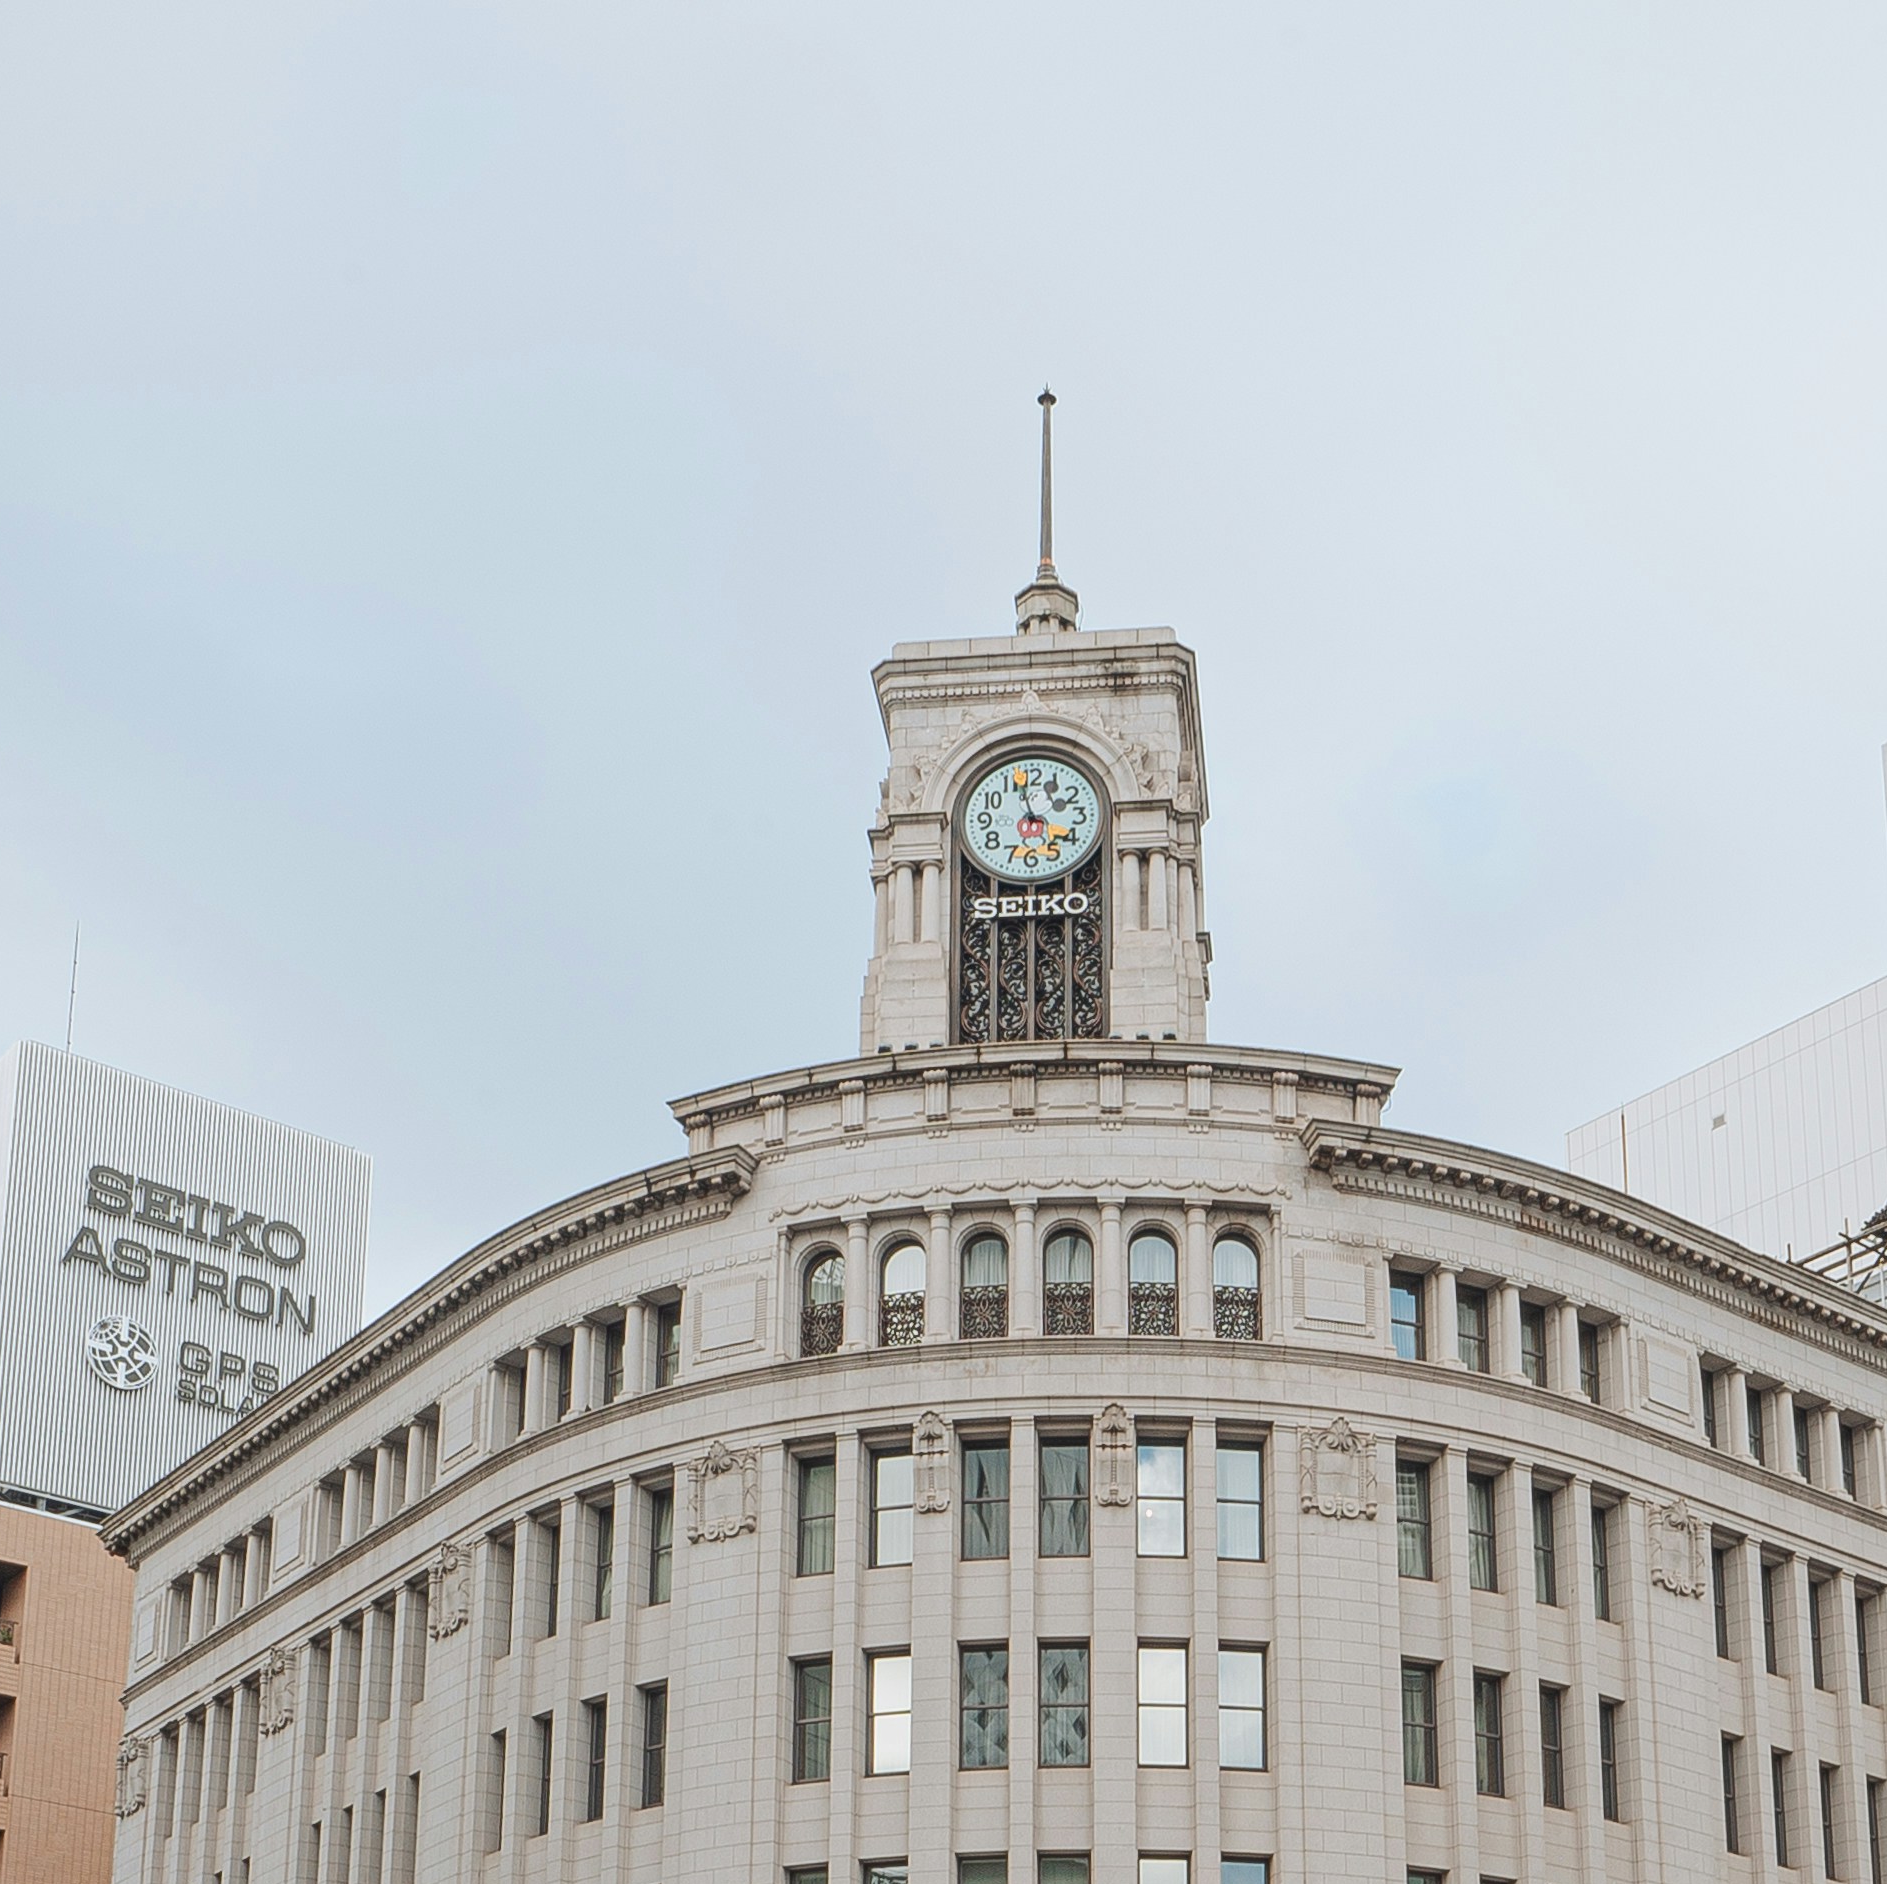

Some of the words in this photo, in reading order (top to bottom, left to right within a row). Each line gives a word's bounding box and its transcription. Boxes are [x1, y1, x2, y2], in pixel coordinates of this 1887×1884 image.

[984, 791, 1002, 810] 10
[1064, 785, 1080, 804] 2
[977, 811, 993, 831] 9
[1071, 806, 1087, 826] 3
[984, 831, 1001, 850] 8
[1003, 844, 1020, 864] 7
[1023, 849, 1039, 868] 6
[1046, 842, 1061, 862] 5
[973, 892, 1089, 919] SEIKO
[86, 1165, 307, 1269] SEIKO
[62, 1226, 316, 1335] ASTRON
[179, 1341, 279, 1396] GPS
